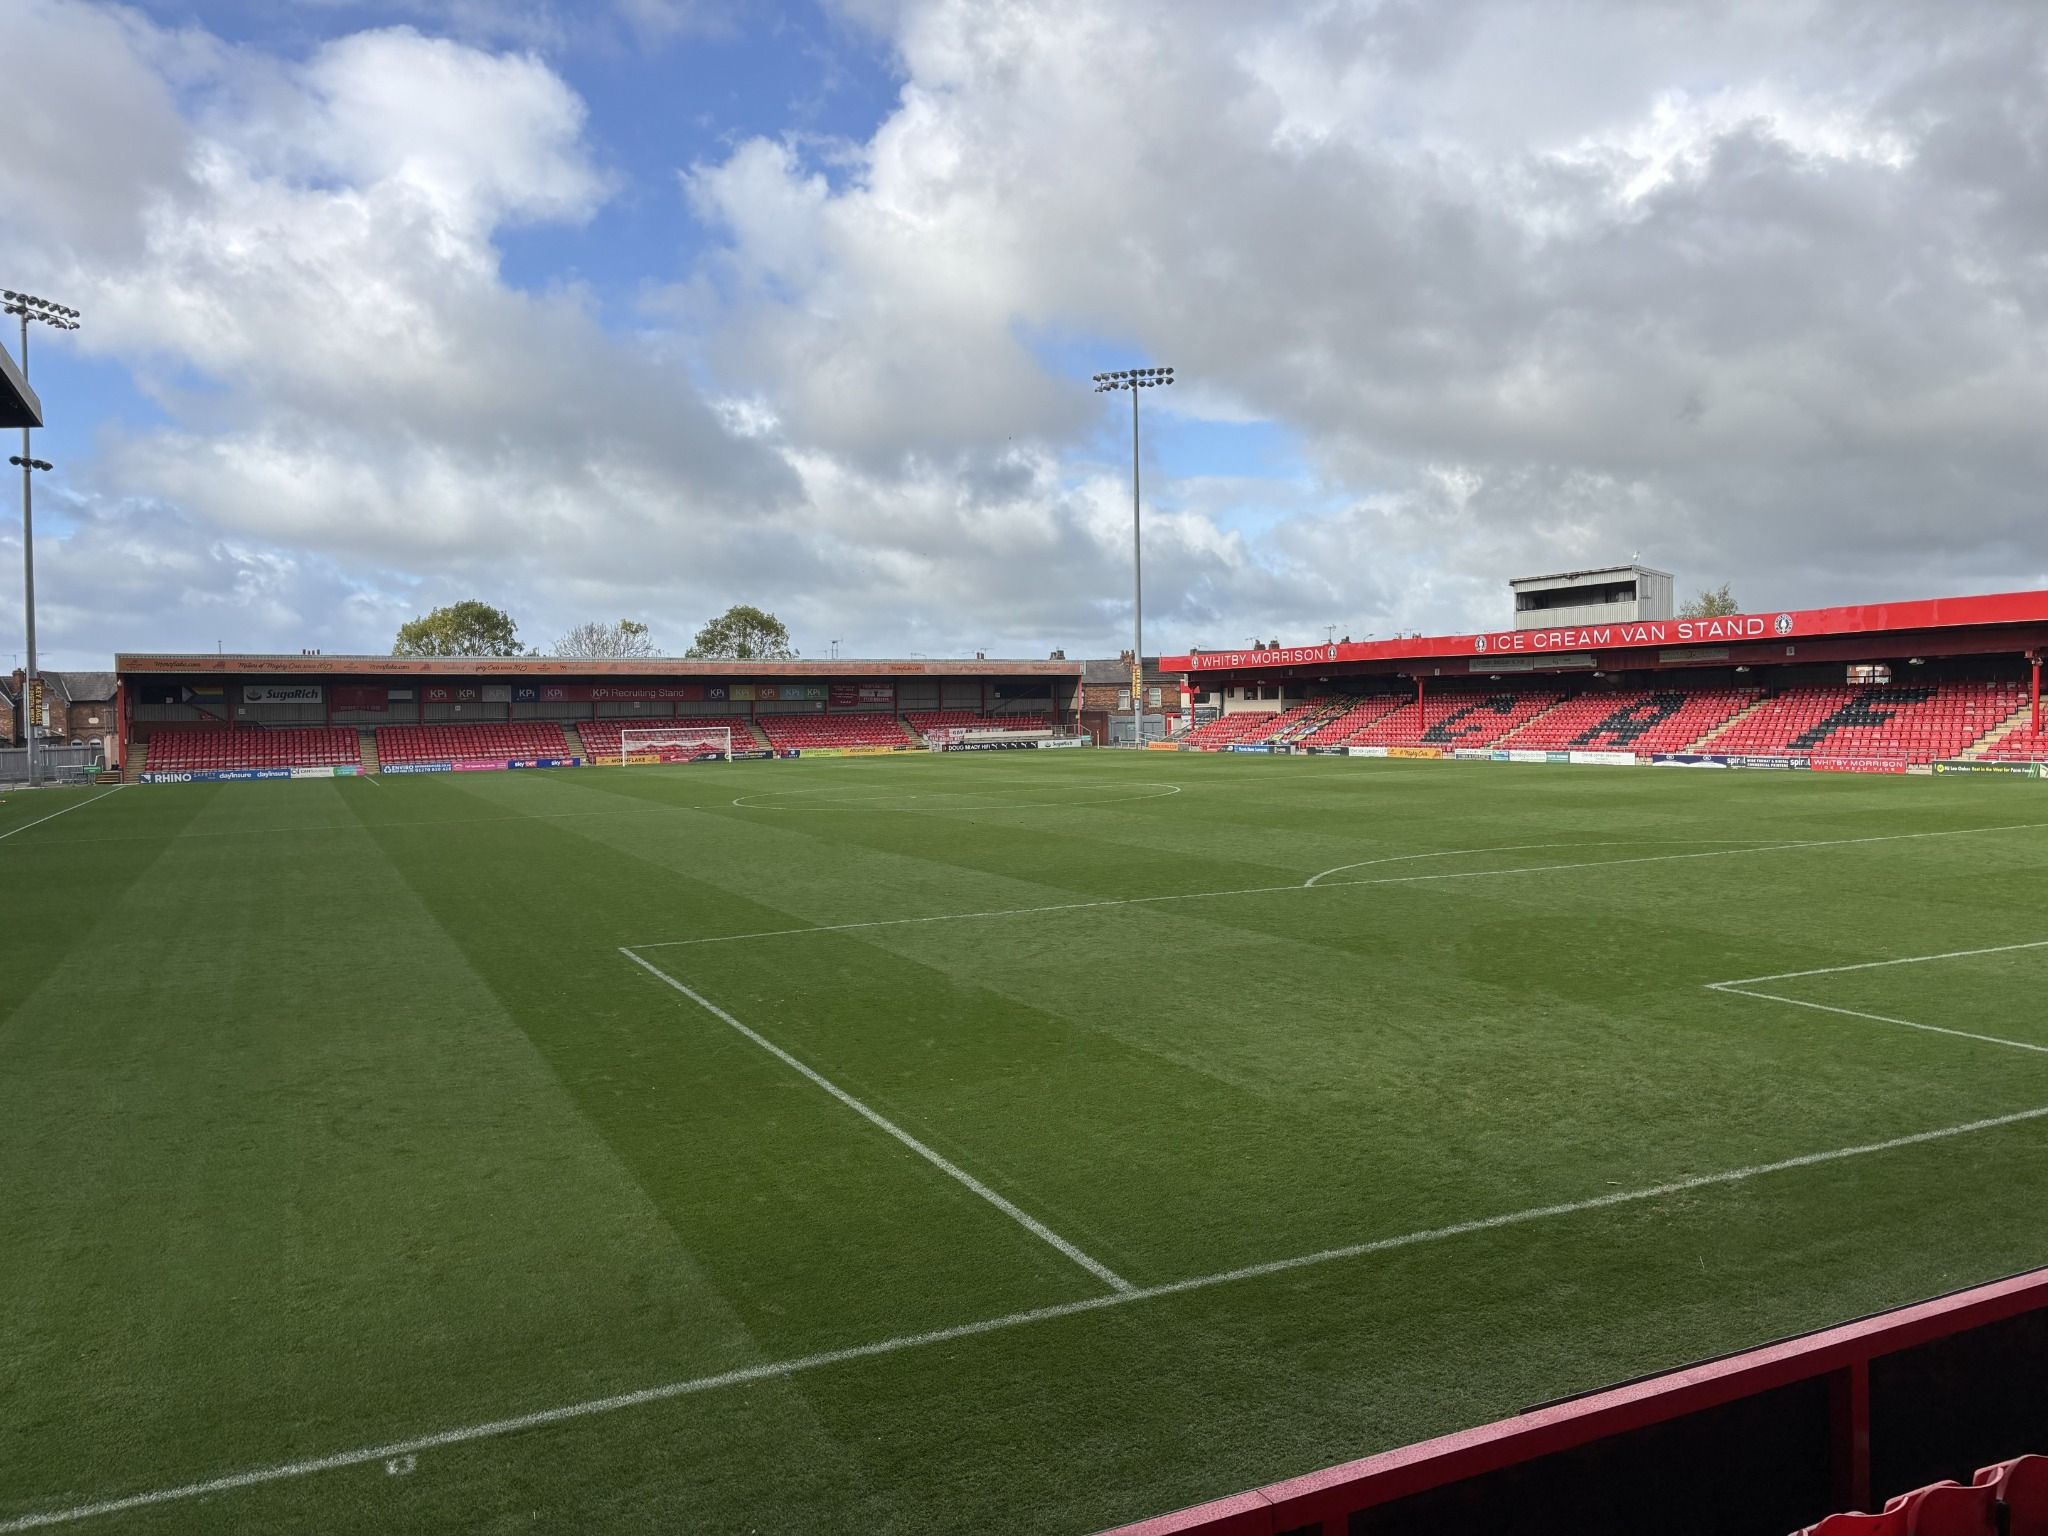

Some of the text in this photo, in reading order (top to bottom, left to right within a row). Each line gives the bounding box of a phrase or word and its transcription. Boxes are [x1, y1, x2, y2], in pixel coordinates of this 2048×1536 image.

[1493, 635, 1524, 650] ICE
[1533, 628, 1610, 648] CREAM
[1621, 624, 1665, 642] VAN
[1678, 618, 1765, 639] STAND
[1202, 648, 1324, 667] WHITBY MORRISON
[266, 688, 318, 700] SugaRich
[612, 688, 656, 699] Recruiting
[658, 688, 684, 697] Stand
[154, 773, 192, 783] RHINO
